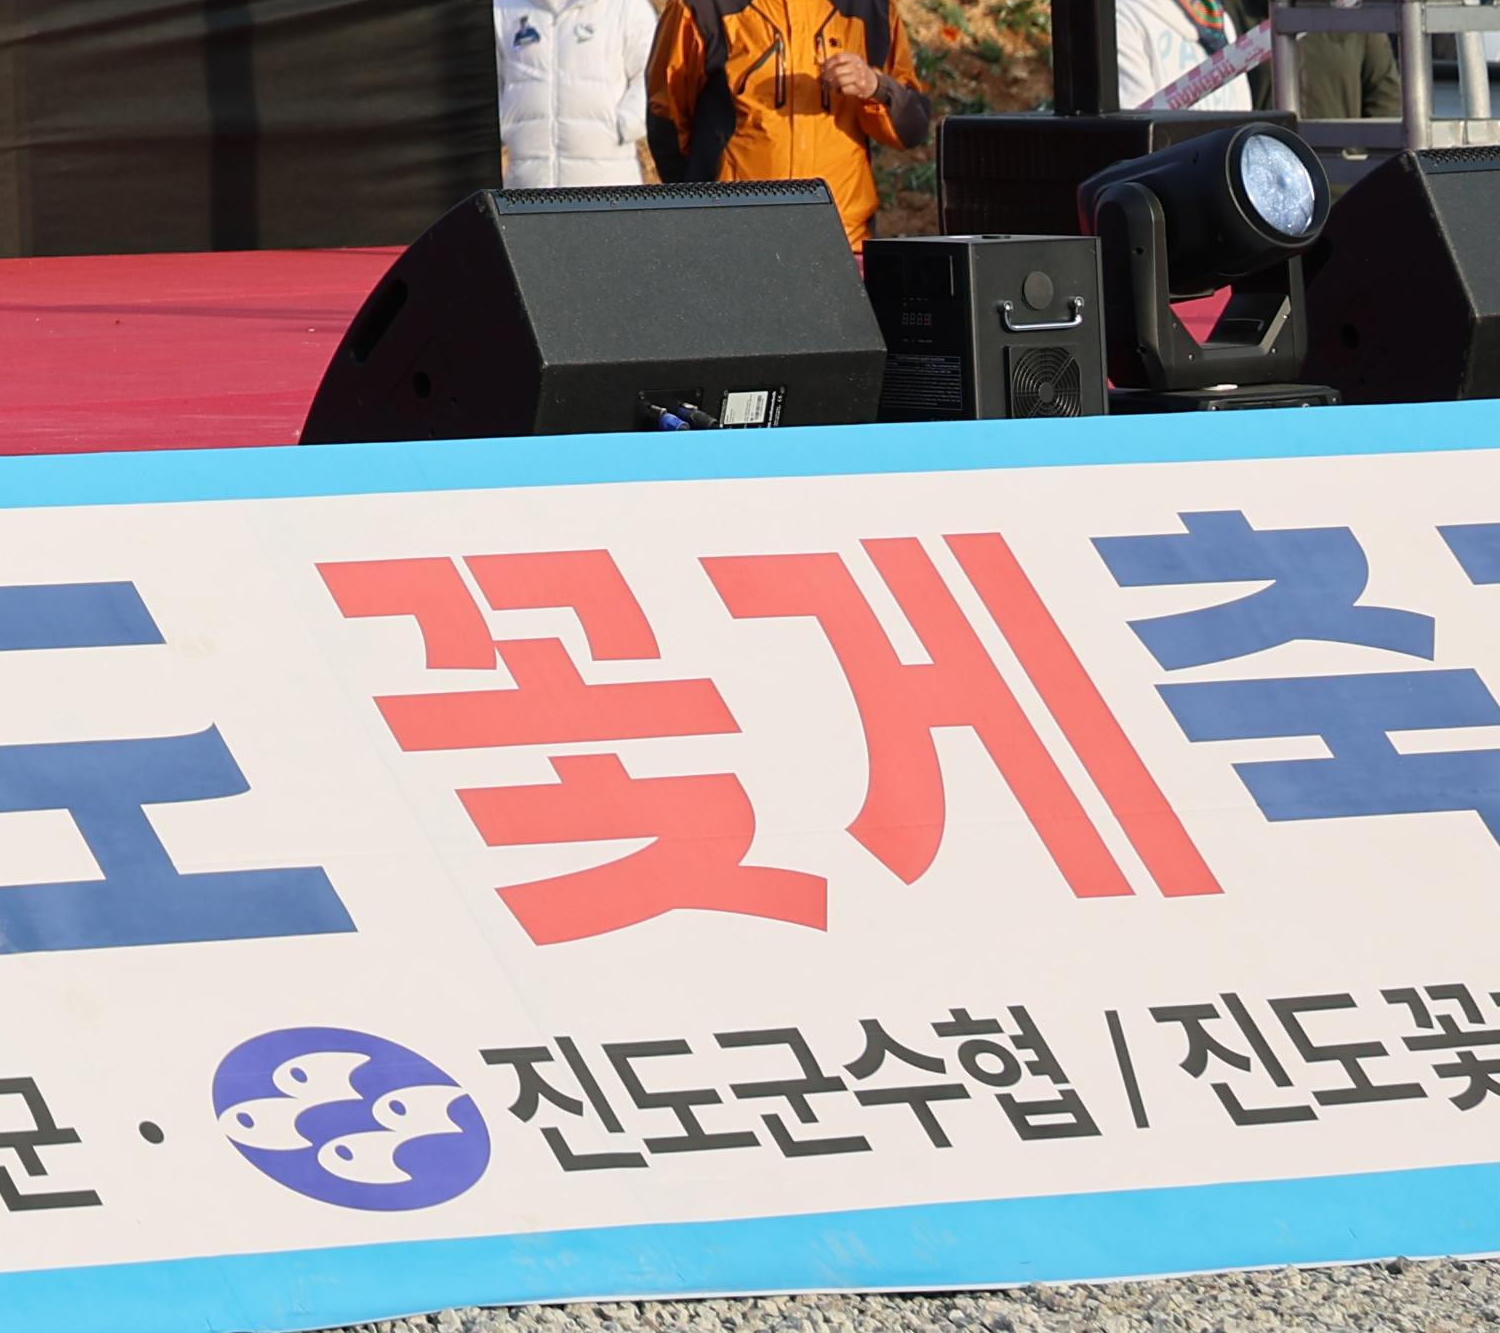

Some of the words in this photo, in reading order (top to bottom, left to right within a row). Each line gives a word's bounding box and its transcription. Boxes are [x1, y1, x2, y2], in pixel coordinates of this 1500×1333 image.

[316, 508, 1500, 947] 꽃게축
[480, 1001, 1101, 1173] 진도군수협
[1147, 981, 1500, 1129] 진도꽃
